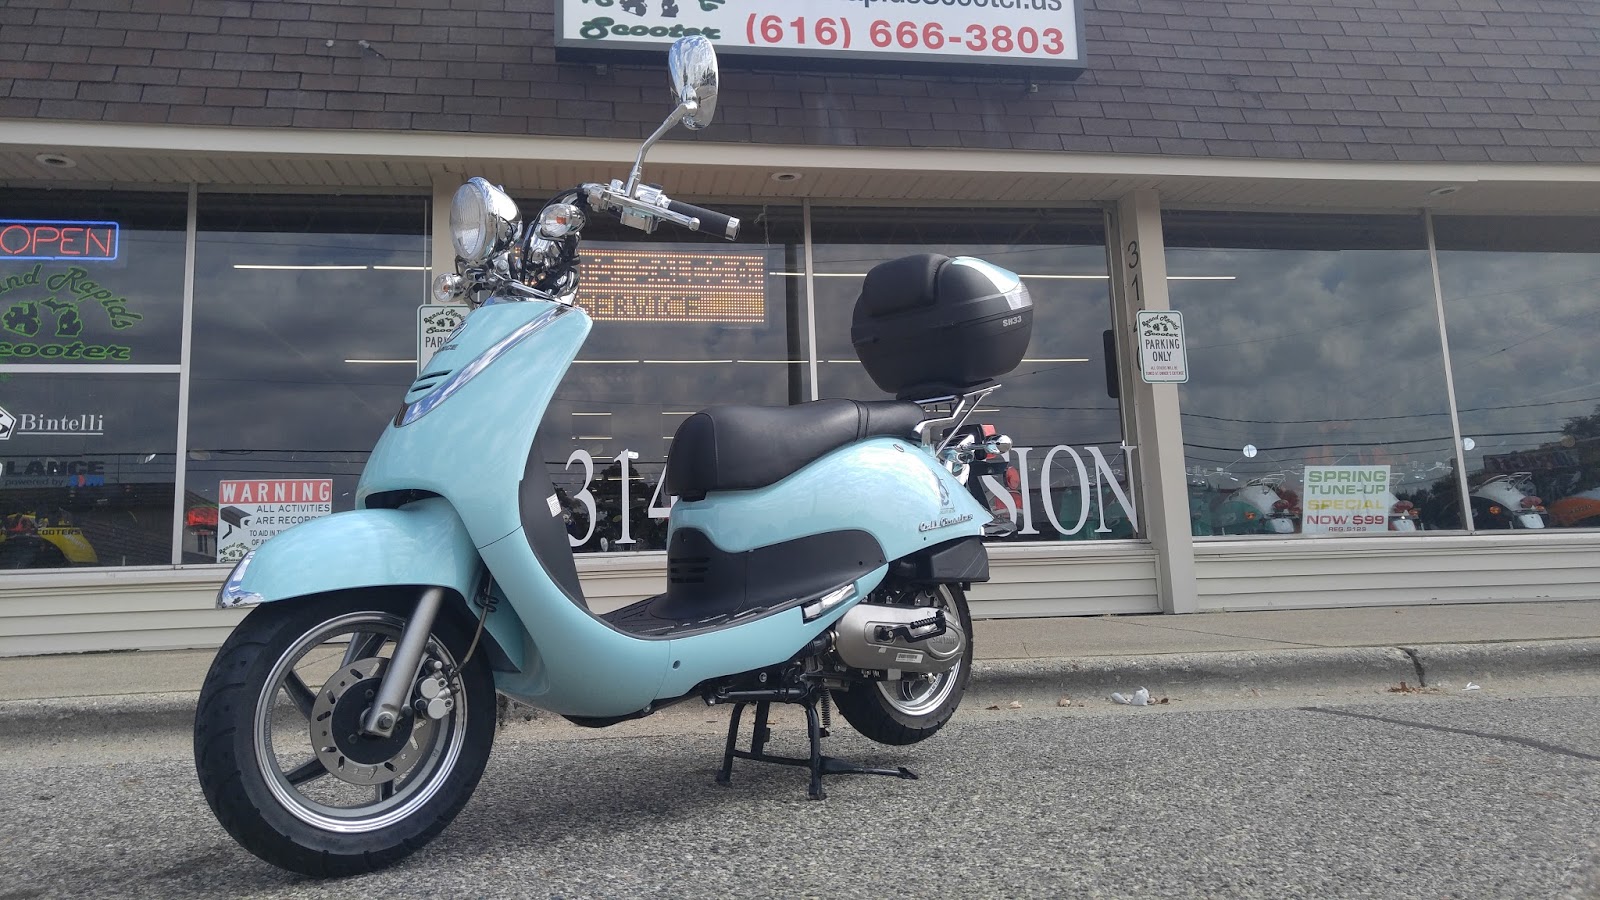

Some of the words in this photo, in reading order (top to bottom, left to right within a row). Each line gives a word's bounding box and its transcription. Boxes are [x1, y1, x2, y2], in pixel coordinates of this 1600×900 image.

[579, 17, 721, 39] Scooter
[746, 13, 850, 48] (616)
[869, 19, 1065, 55] 666-3803
[0, 225, 112, 256] OPEN
[47, 266, 143, 330] Rapids
[1003, 315, 1022, 327] SH33
[1145, 339, 1180, 350] PARKING
[1153, 351, 1172, 361] ONLY
[18, 413, 104, 431] Bintelli
[6, 461, 105, 475] LANCE
[1308, 470, 1387, 483] SPRING
[52, 478, 64, 488] by
[222, 482, 330, 503] WARNING
[1308, 484, 1386, 495] TUNE-UP
[256, 505, 275, 513] ALL
[278, 504, 331, 512] ACTIVITIES
[1307, 499, 1385, 510] SPECIAL
[255, 516, 275, 525] ARE
[1306, 515, 1348, 525] NOW
[1352, 514, 1385, 526] $99
[250, 529, 258, 537] TO
[258, 529, 269, 537] AID
